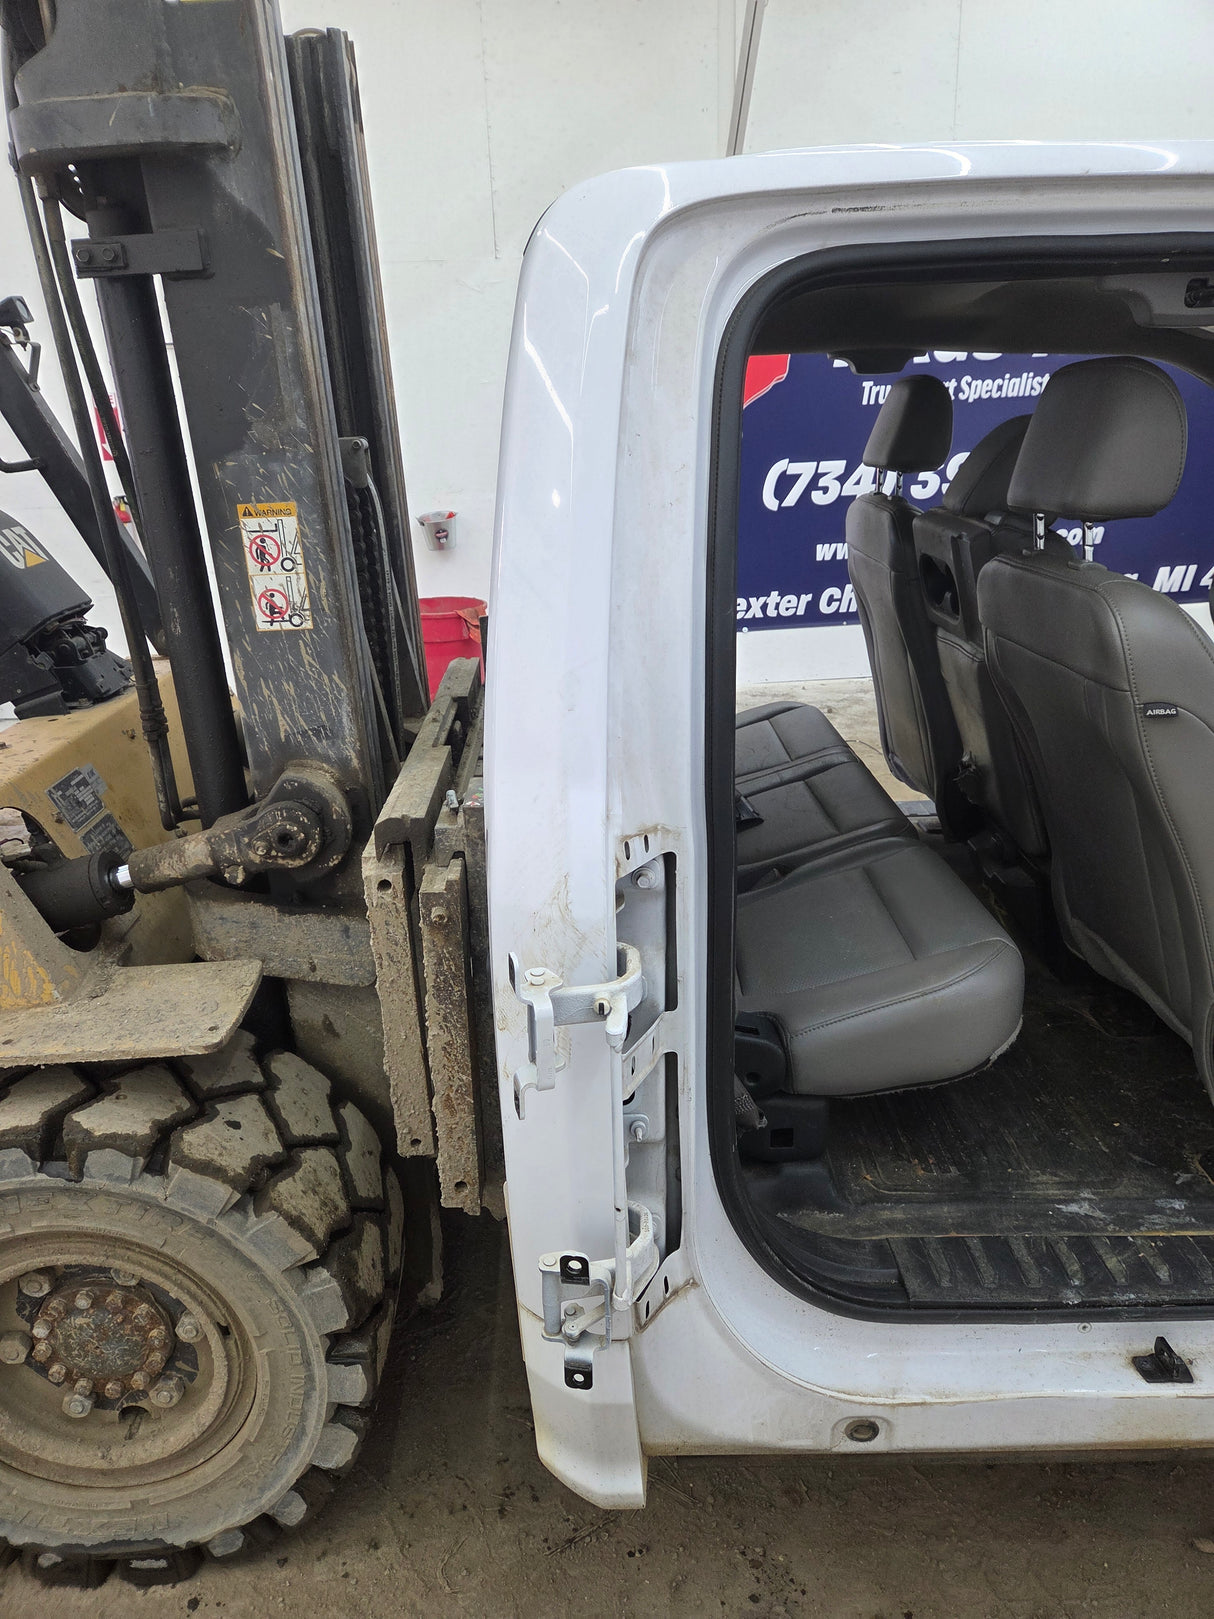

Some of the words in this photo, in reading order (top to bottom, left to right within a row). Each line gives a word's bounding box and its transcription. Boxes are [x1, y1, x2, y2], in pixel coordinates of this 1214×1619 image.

[253, 507, 292, 517] WARNING
[0, 526, 49, 569] CAT
[1152, 564, 1198, 593] MI
[1145, 708, 1177, 716] AIRBAG
